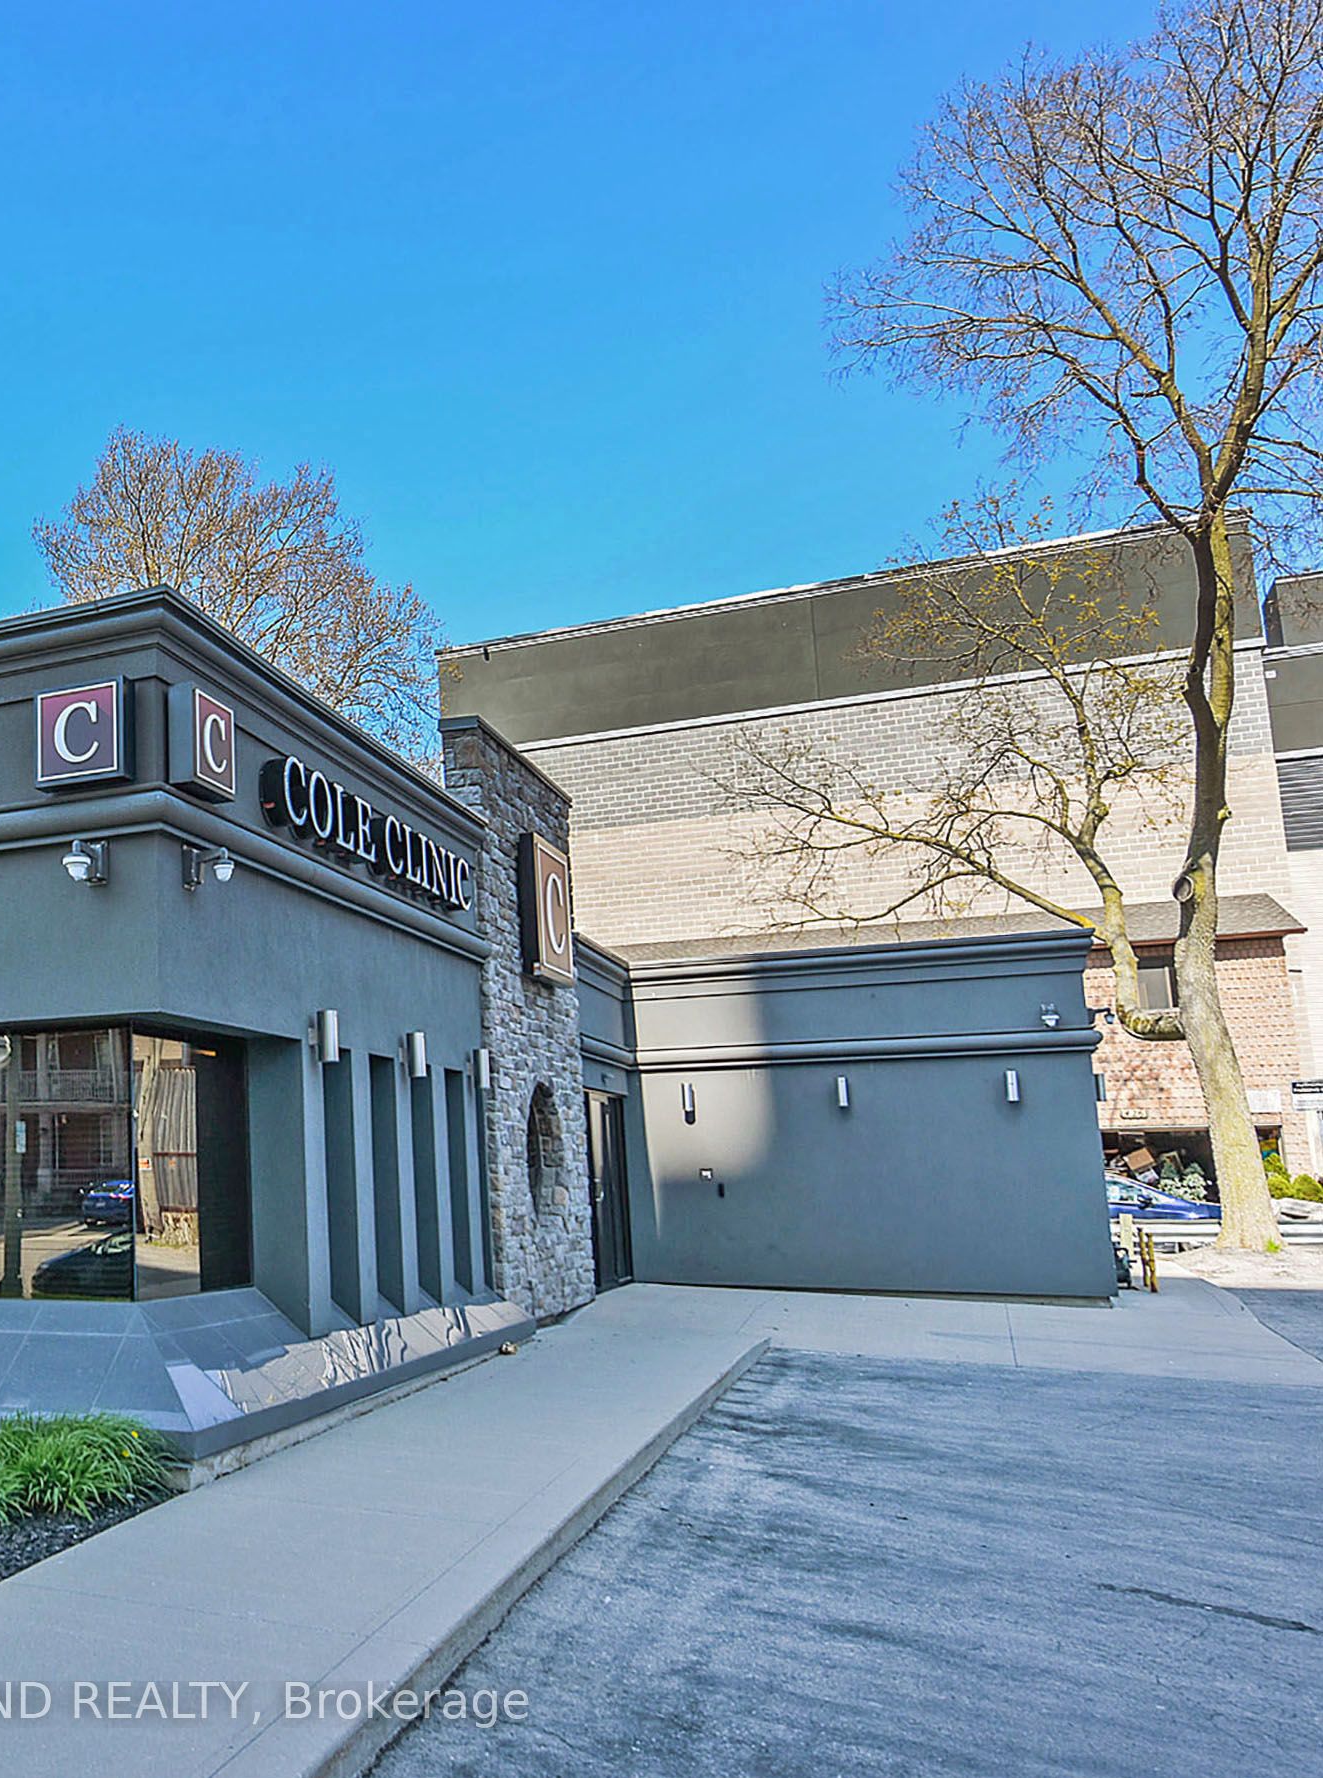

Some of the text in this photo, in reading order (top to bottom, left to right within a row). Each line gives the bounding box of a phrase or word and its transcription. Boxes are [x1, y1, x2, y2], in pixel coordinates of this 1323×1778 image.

[53, 700, 100, 765] C
[202, 713, 227, 774] C
[283, 755, 472, 911] COLE CLINIC
[545, 872, 567, 956] C
